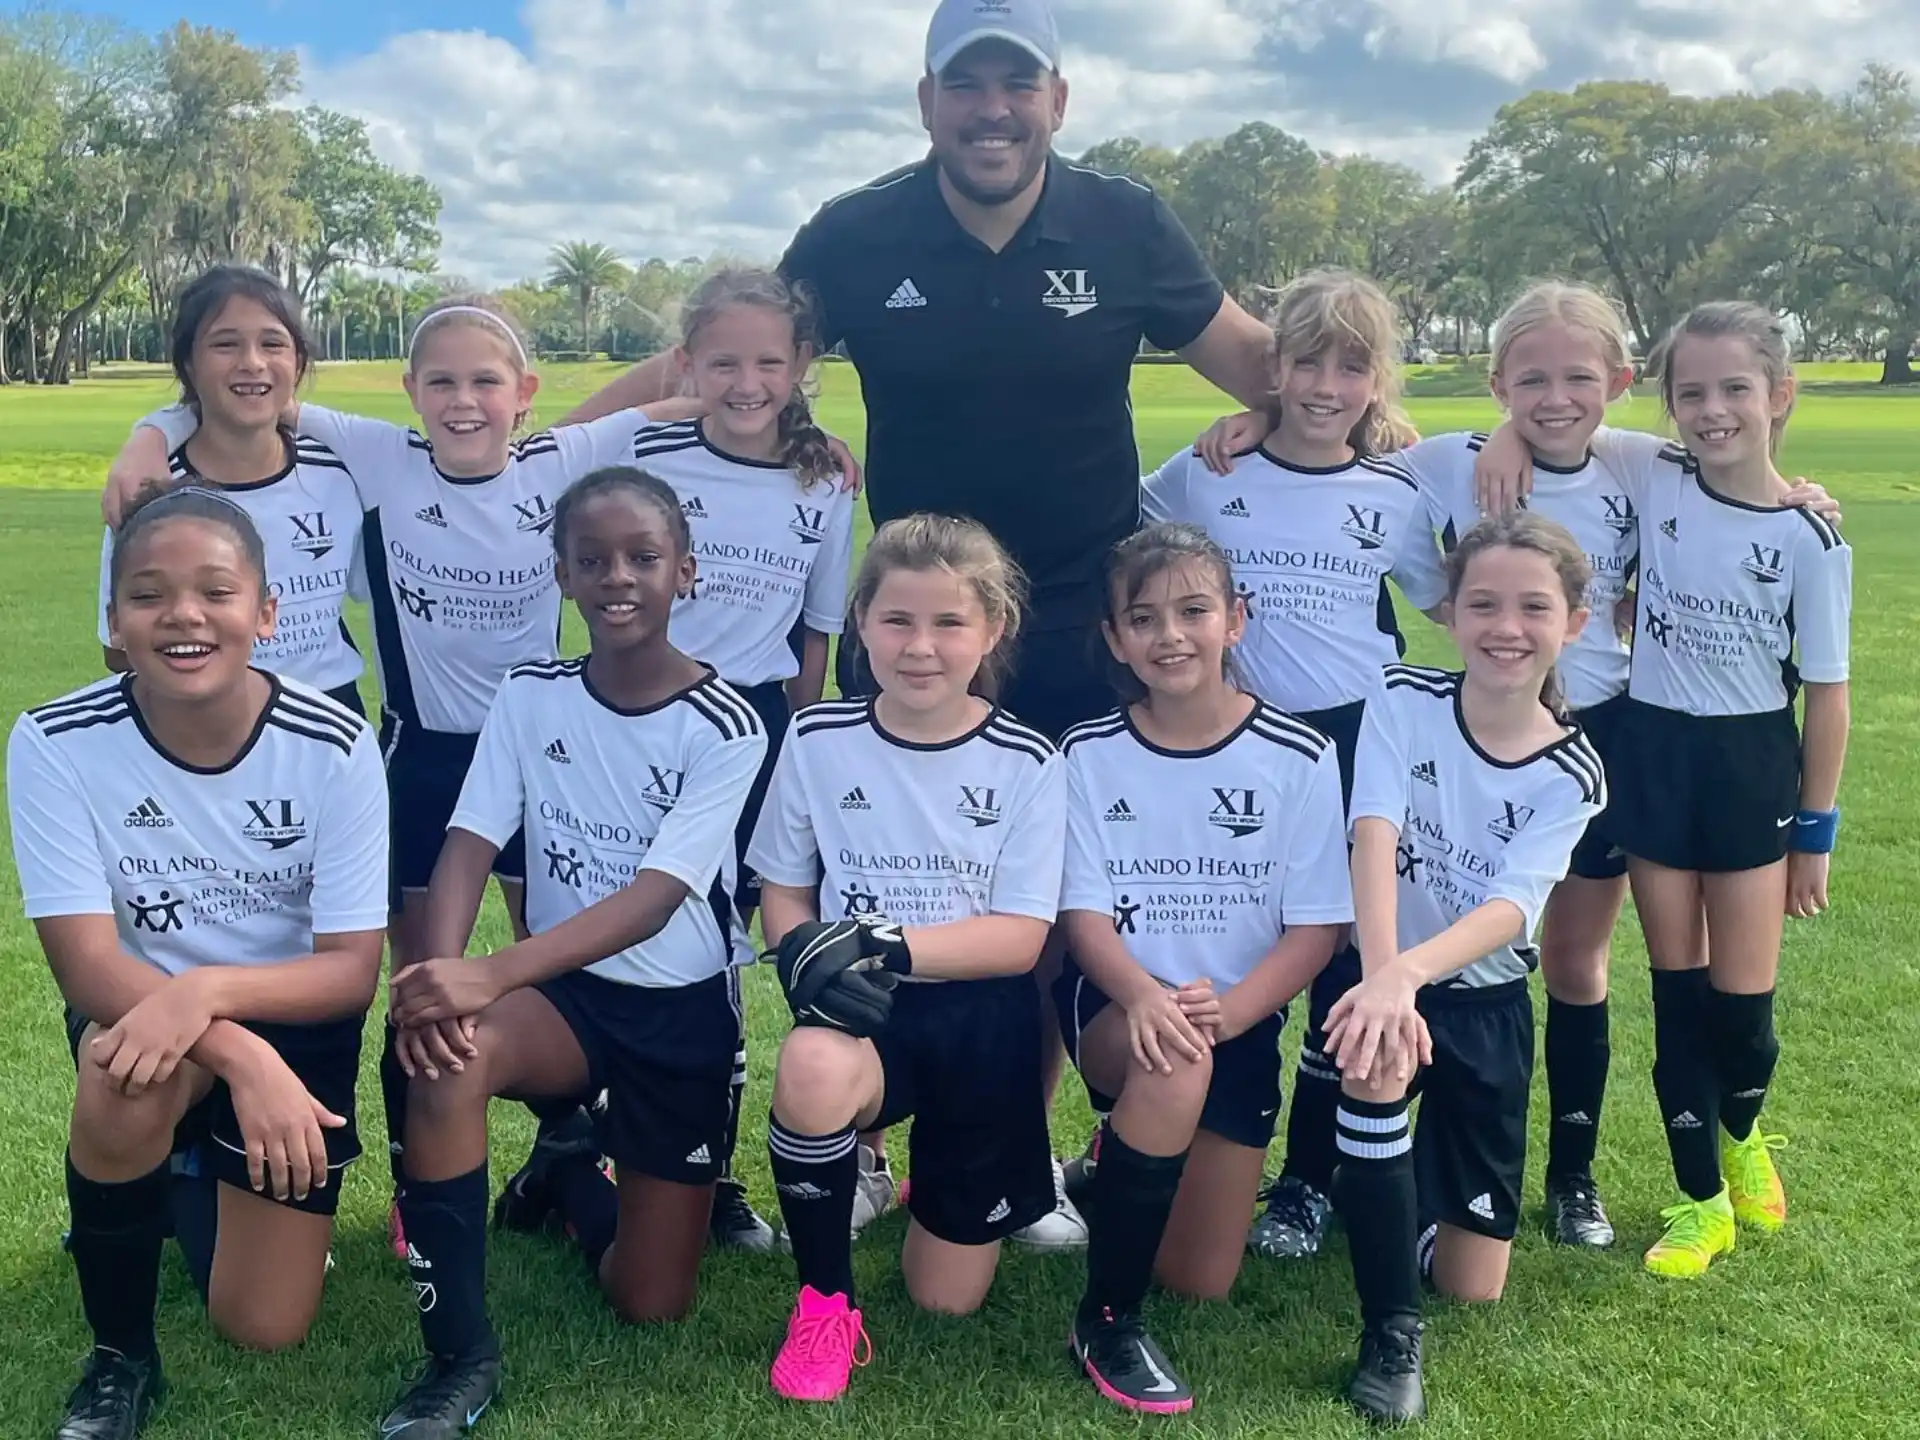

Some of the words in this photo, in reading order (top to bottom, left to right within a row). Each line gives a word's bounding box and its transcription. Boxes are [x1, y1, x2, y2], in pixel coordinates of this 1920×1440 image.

[1043, 269, 1096, 296] XL
[885, 296, 928, 309] adidas
[512, 494, 556, 525] XL
[791, 502, 826, 533] XL
[288, 511, 333, 541] XL
[1343, 502, 1388, 538] XL
[691, 540, 750, 561] LANDO
[1743, 541, 1785, 573] XL
[390, 540, 492, 585] ORLANDO
[1223, 548, 1306, 568] RLANDO
[1311, 551, 1379, 579] HEALTH
[708, 571, 761, 588] ARNOLD
[705, 582, 766, 602] HOSPITAL
[1260, 581, 1326, 597] ARNOLD
[441, 595, 513, 609] ARNOLD
[1260, 597, 1336, 612] HOSPITAL
[443, 606, 525, 621] HOSPITAL
[839, 801, 872, 811] adidas
[957, 784, 1001, 813] XL
[1209, 787, 1265, 817] XL
[123, 815, 175, 828] adidas
[244, 799, 306, 829] XL
[540, 800, 632, 844] ORLANDO
[1103, 812, 1137, 822] adidas
[1208, 815, 1237, 824] SOCCER
[1239, 816, 1265, 824] WORLD
[242, 828, 275, 838] SOCCER
[276, 828, 307, 837] WORLD
[926, 853, 990, 879] HEALTH
[1107, 858, 1191, 876] RLANDO
[883, 885, 942, 898] ARNOLD
[1145, 893, 1213, 906] ARNOLD
[884, 900, 955, 912] HOSPITAL
[1146, 908, 1228, 922] HOSPITAL
[1146, 924, 1167, 935] For
[1171, 923, 1227, 935] Children
